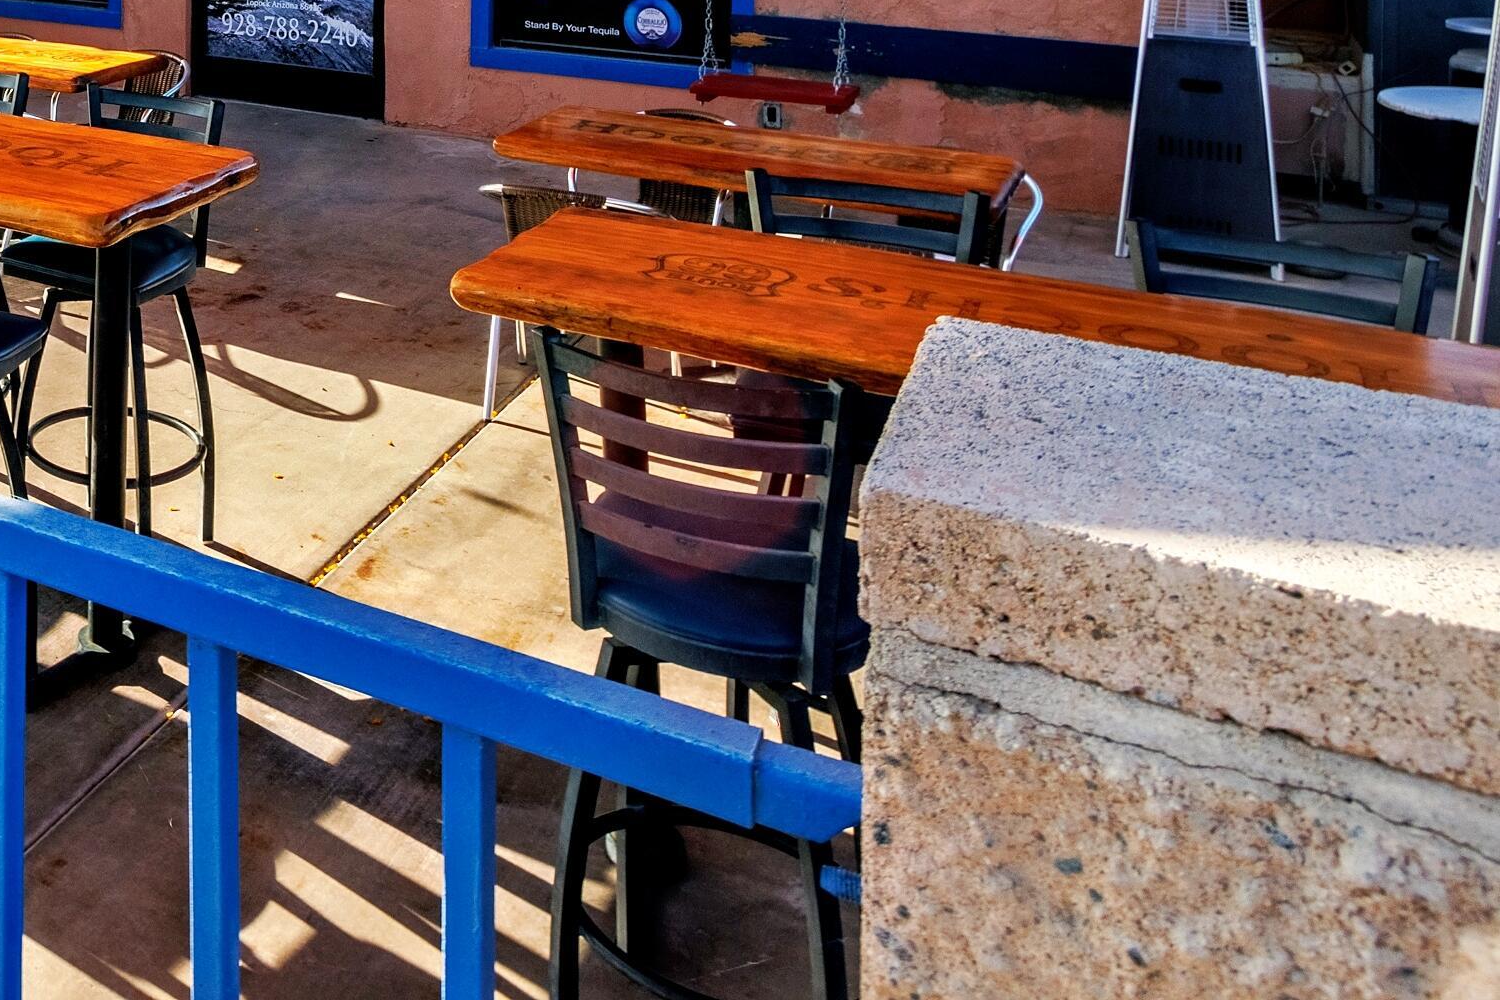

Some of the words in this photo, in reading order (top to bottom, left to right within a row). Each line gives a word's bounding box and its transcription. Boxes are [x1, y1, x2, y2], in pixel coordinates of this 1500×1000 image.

[271, 0, 299, 10] Arizona
[221, 12, 358, 48] 928-788-2240
[524, 20, 550, 30] Stand
[551, 22, 564, 32] By
[565, 23, 587, 33] Your
[587, 25, 620, 36] Tequila
[677, 257, 772, 283] 66
[665, 272, 756, 293] ROUTE
